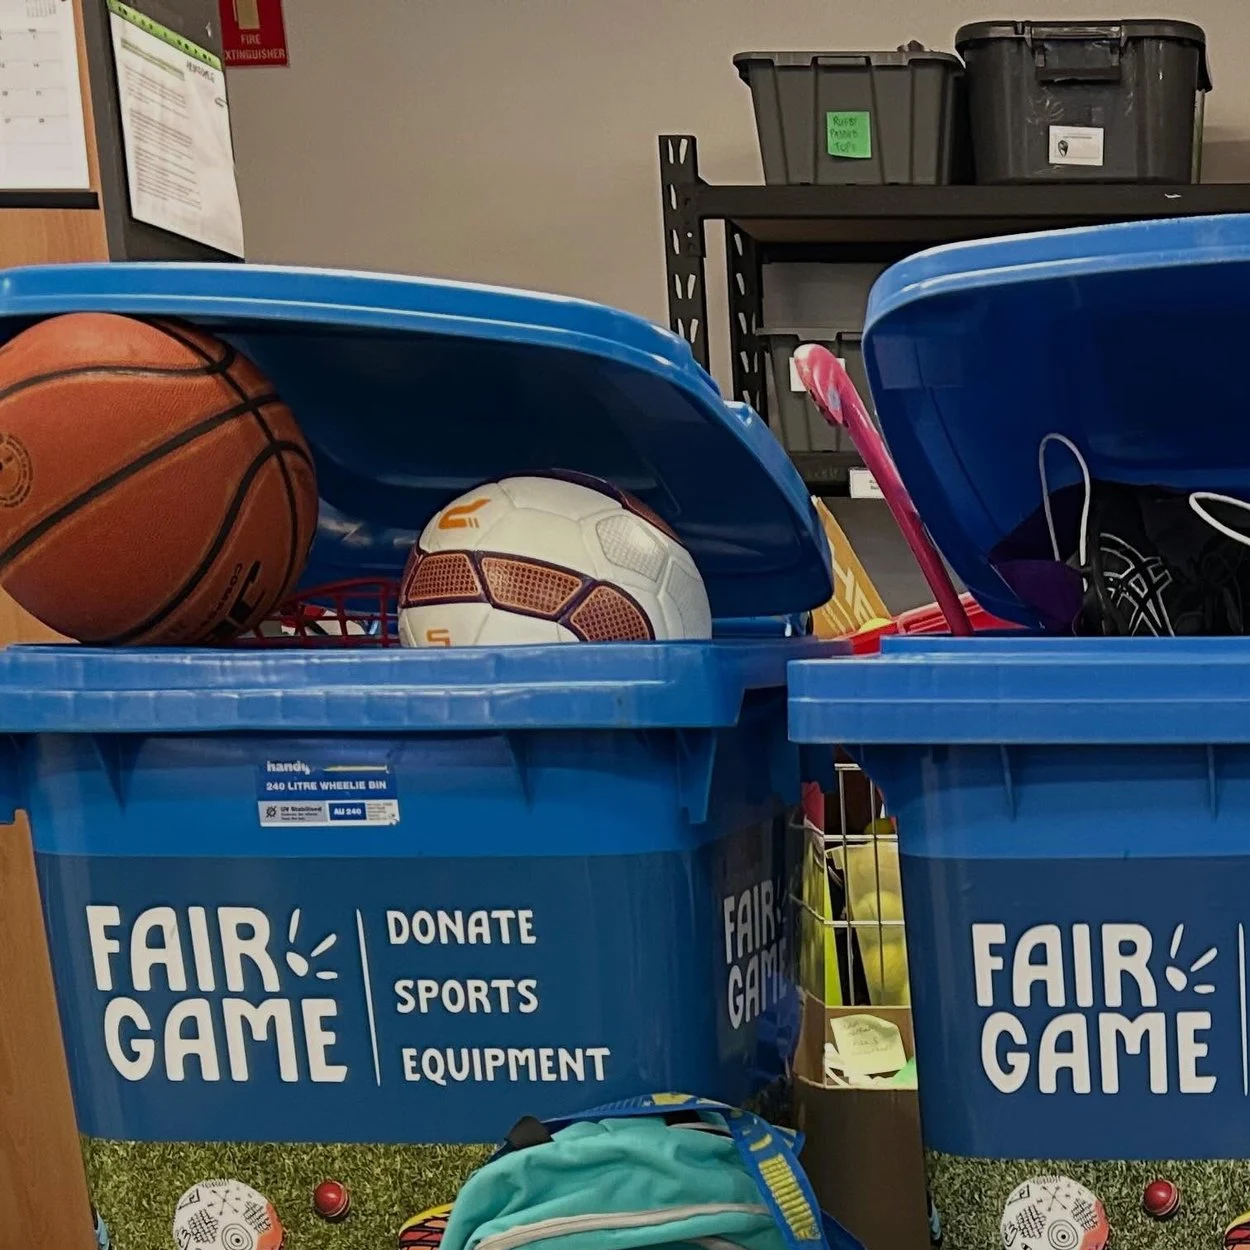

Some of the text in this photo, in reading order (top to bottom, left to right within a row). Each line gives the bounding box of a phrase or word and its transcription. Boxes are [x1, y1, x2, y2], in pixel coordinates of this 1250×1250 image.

[225, 48, 286, 61] XTINGUISHER
[240, 33, 261, 45] FIRE
[266, 760, 311, 775] handy
[266, 780, 387, 791] 240 LITRE WHEELIE BIN
[386, 909, 537, 945] DONATE
[723, 879, 776, 965] FAIR
[85, 905, 281, 993] FAIR
[971, 923, 1157, 1008] FAIR
[394, 979, 539, 1014] SPORTS
[727, 937, 788, 1030] GAME
[104, 997, 348, 1083] GAME
[981, 1011, 1218, 1094] GAME
[402, 1047, 611, 1086] EQUIPMENT
